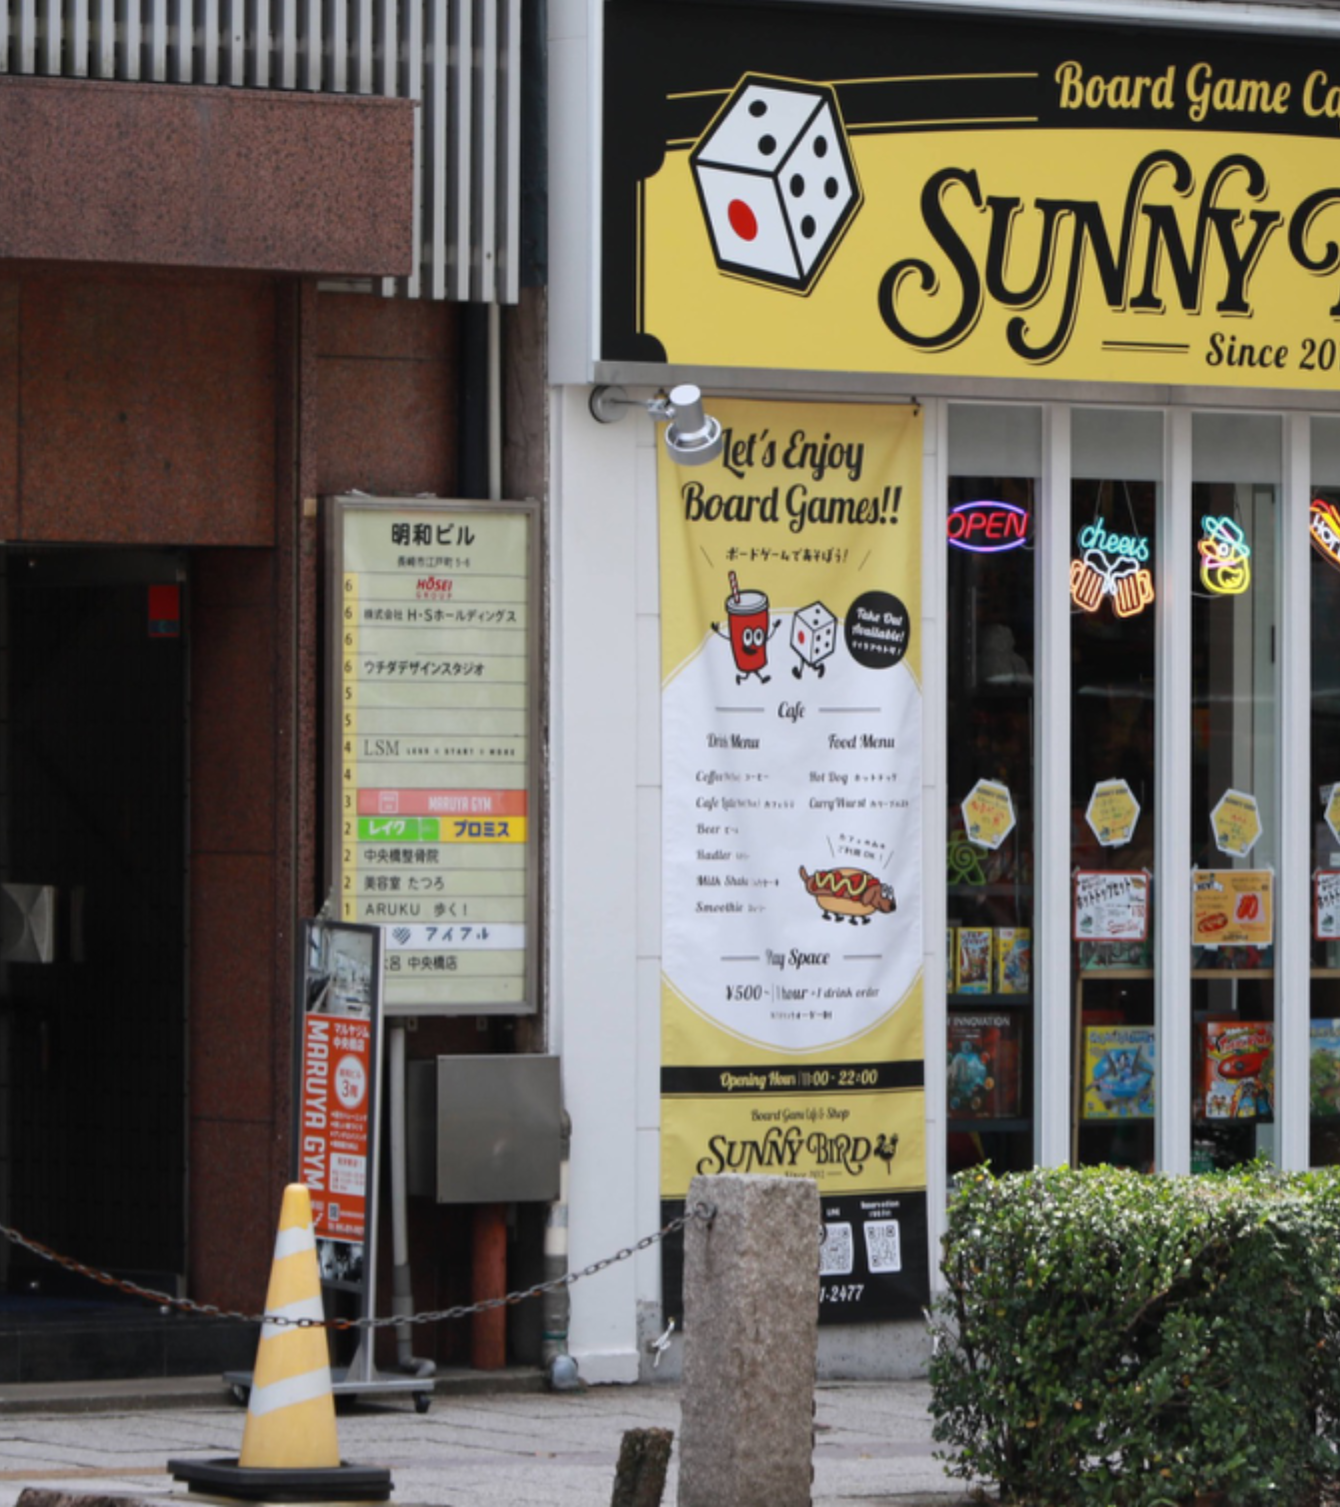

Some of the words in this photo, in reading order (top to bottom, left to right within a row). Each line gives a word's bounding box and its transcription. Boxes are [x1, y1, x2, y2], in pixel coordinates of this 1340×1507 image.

[1055, 60, 1176, 111] Board
[1186, 63, 1291, 122] Game
[877, 149, 1283, 365] SUNNY
[1205, 332, 1288, 369] Since
[722, 428, 776, 479] Let's
[782, 429, 865, 481] Enjoy
[681, 481, 780, 523] Board
[786, 483, 903, 533] Games!!
[392, 522, 476, 546] 明和ビル
[946, 511, 1028, 540] OPEN
[1311, 513, 1340, 555] HOT
[364, 660, 485, 676] ウチダデザインスタジオ
[777, 700, 806, 723] Cafe
[364, 739, 400, 756] LSM
[730, 733, 760, 749] Menu
[828, 733, 857, 749] Food
[860, 733, 895, 749] Menu
[809, 771, 825, 783] Hot
[828, 771, 848, 786] Dog
[453, 819, 510, 837] プロミス
[697, 822, 720, 834] Beer
[364, 876, 401, 891] 美容室
[365, 903, 421, 916] ARUKU
[765, 948, 786, 971] Pay
[788, 948, 831, 970] Space
[823, 987, 853, 998] drink
[953, 1016, 1011, 1028] INNOVATION
[304, 1020, 329, 1129] MARUYA
[720, 1071, 767, 1090] Opening
[838, 1069, 879, 1085] 22:00
[751, 1109, 781, 1121] Board
[696, 1126, 806, 1176] SUNNY
[806, 1132, 872, 1176] BIRD
[303, 1136, 326, 1191] GYM
